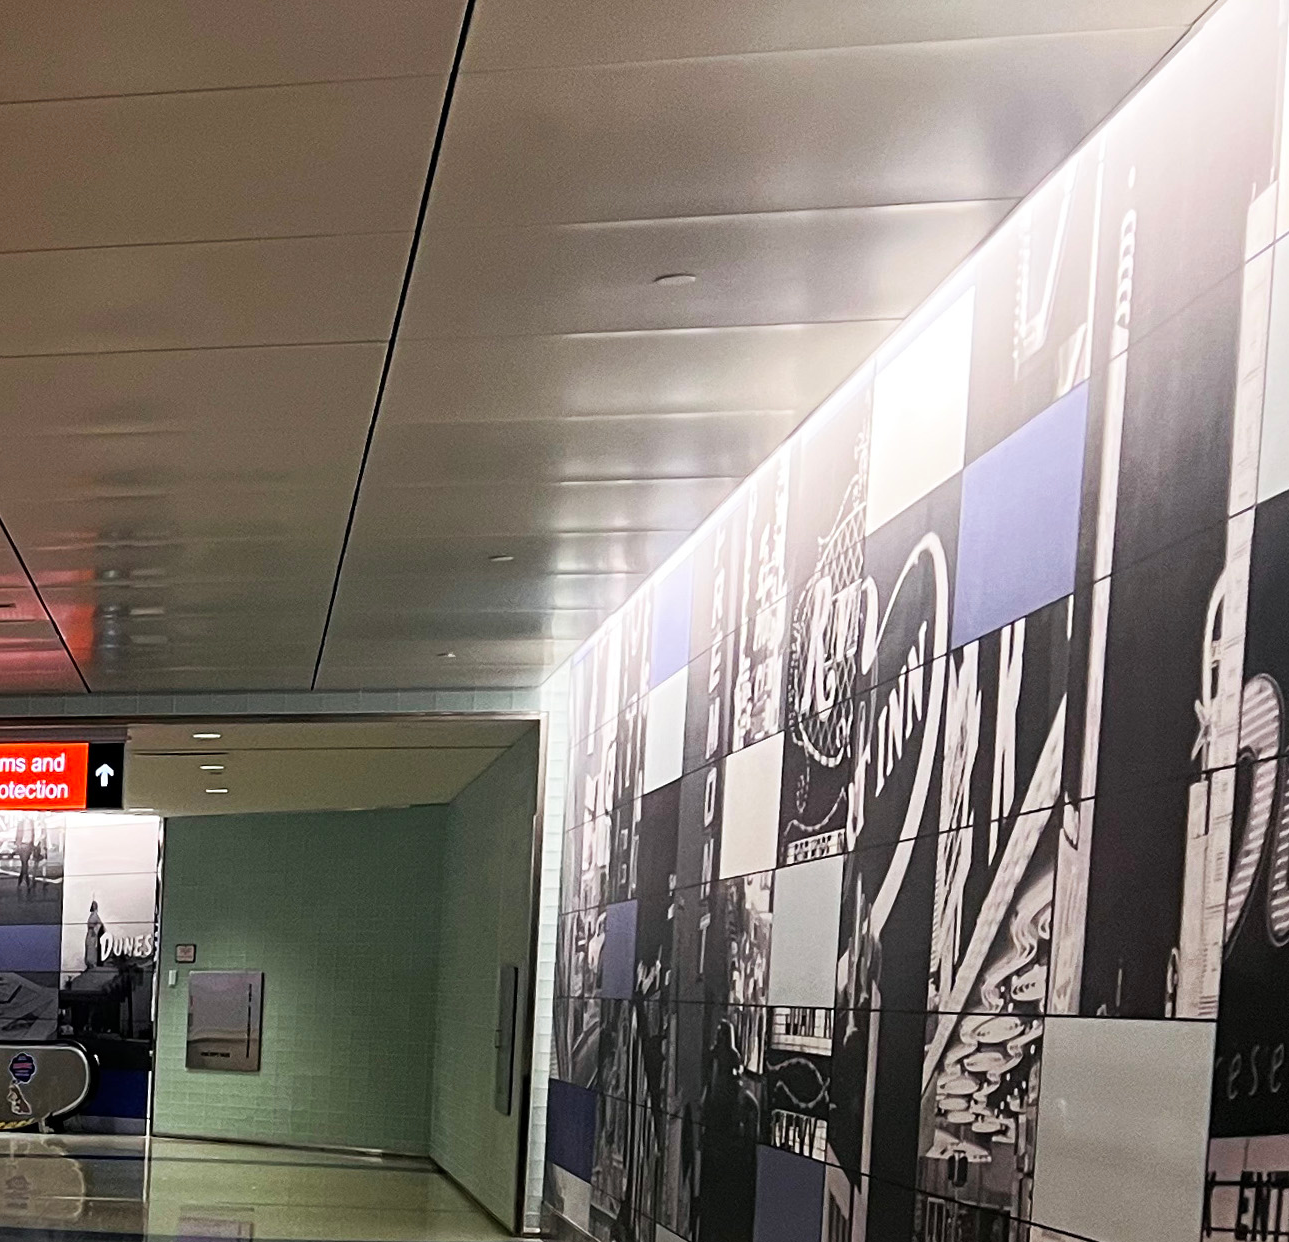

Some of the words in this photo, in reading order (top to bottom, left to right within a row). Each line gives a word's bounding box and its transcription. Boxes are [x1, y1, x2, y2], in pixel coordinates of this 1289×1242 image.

[875, 620, 927, 797] INN
[31, 752, 66, 773] and
[100, 932, 153, 962] DUNES
